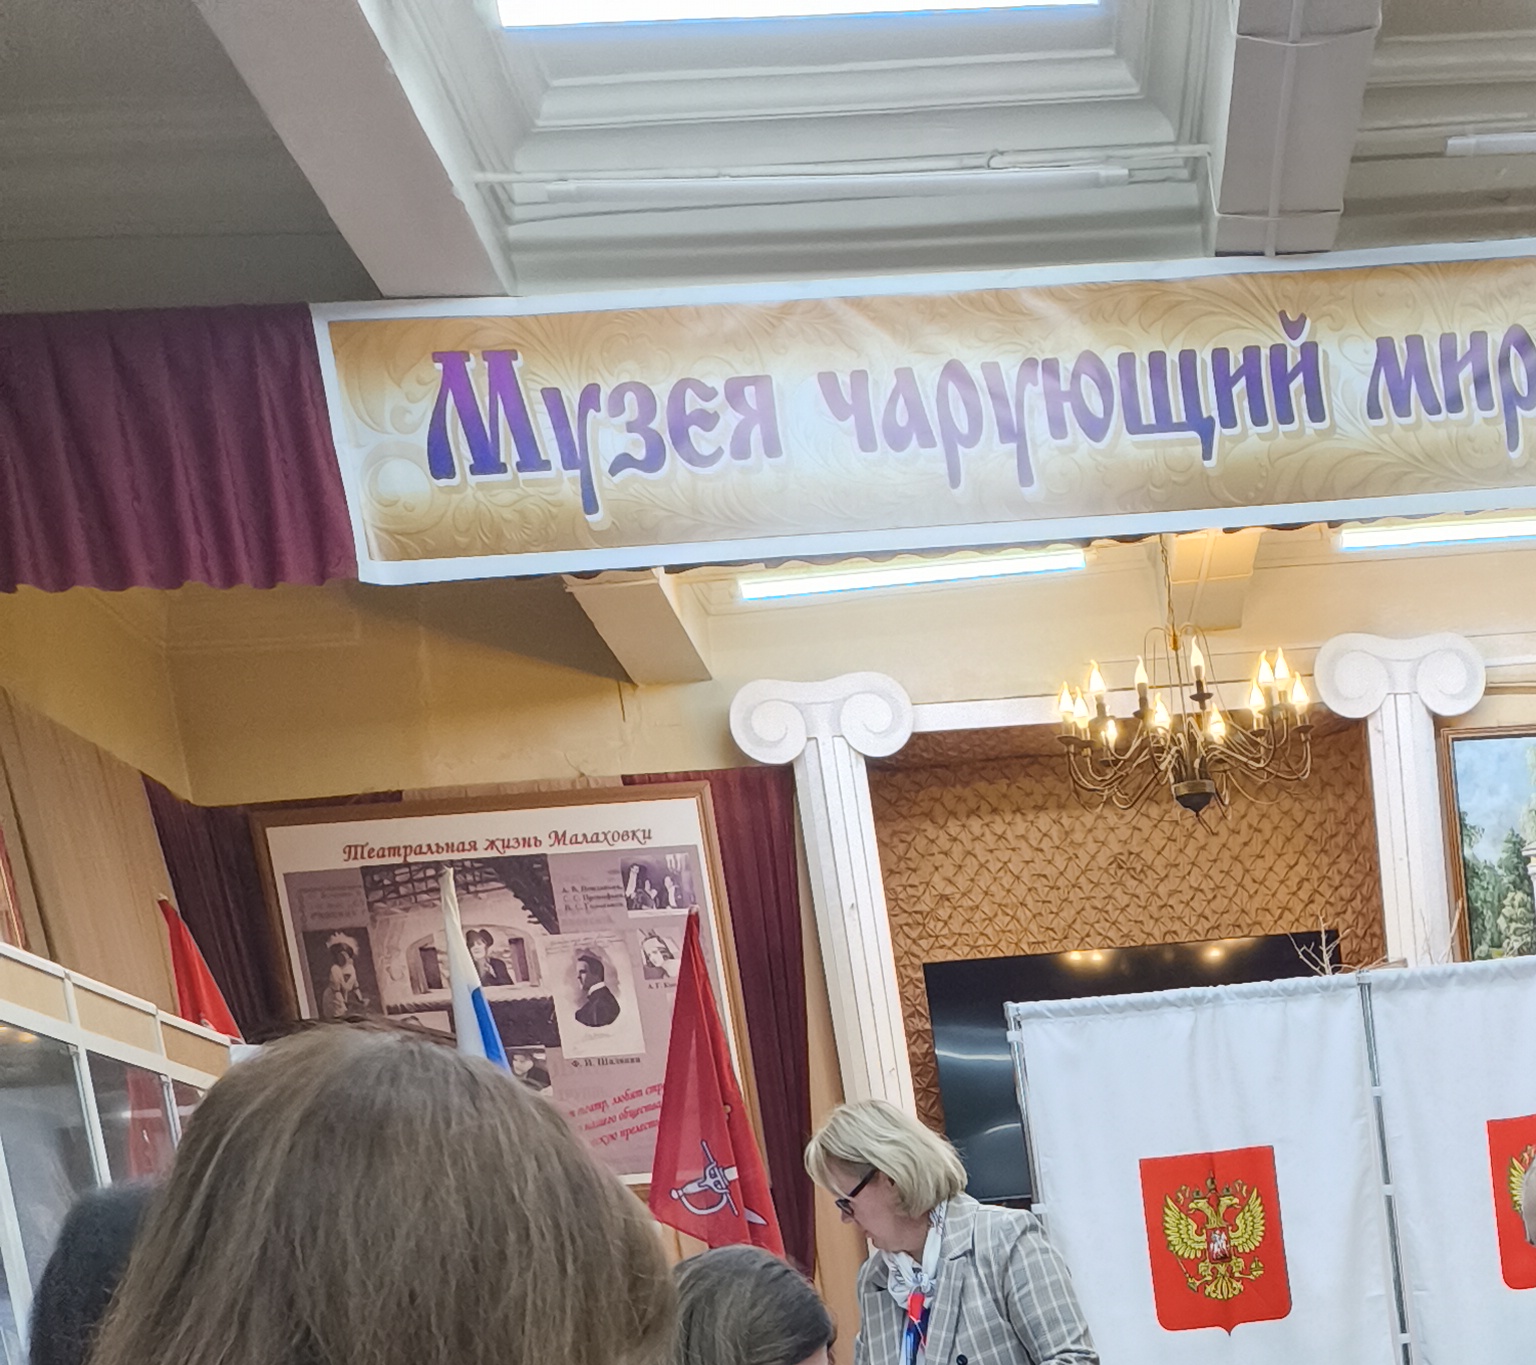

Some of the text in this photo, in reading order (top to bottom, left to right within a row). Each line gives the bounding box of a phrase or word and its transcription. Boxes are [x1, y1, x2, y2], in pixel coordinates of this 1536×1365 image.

[427, 349, 783, 519] Музея
[817, 310, 1327, 489] чарующий
[342, 826, 653, 864] Театральная жизнь Малаховки
